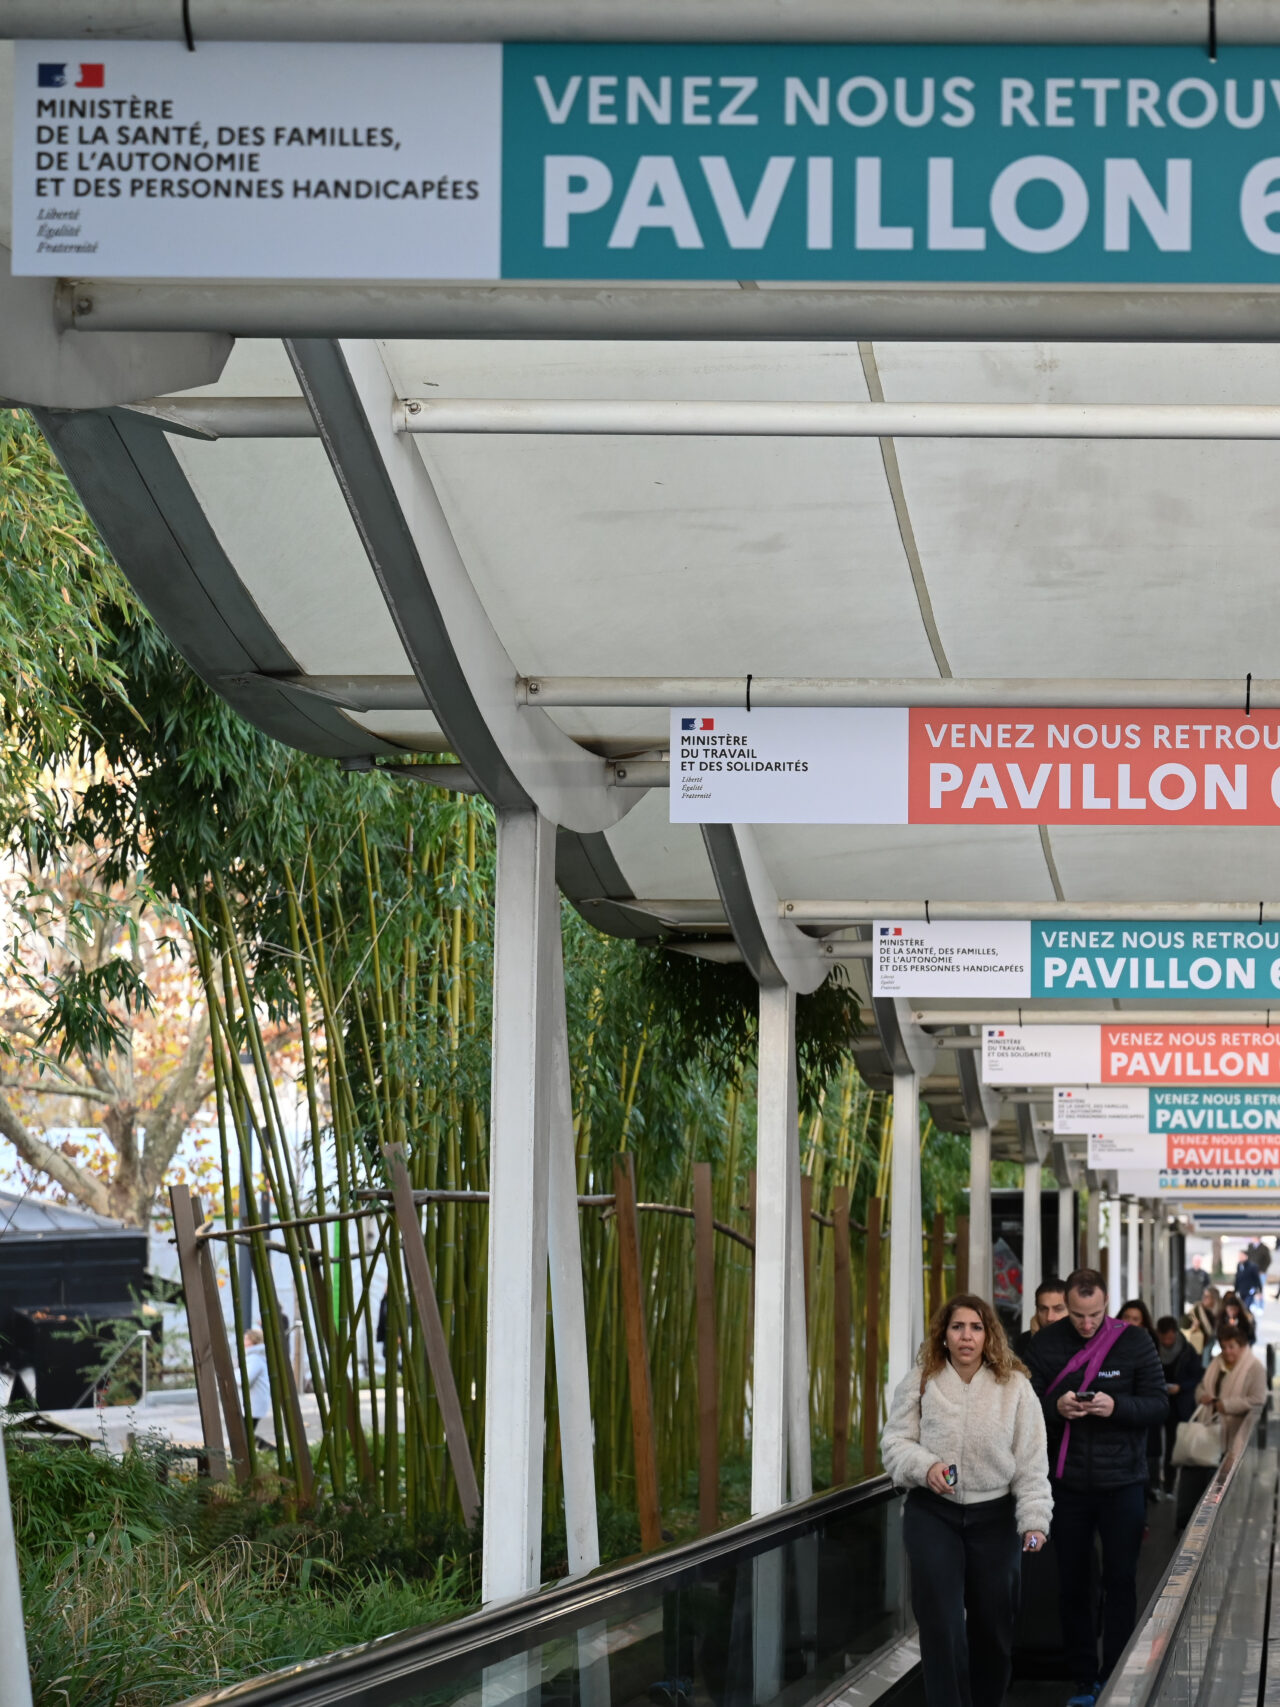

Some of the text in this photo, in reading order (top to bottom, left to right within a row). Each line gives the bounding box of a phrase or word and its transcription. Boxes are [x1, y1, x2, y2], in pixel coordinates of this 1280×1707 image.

[36, 95, 173, 119] MINISTÈRE
[535, 76, 758, 125] VENEZ
[785, 76, 975, 128] NOUS
[36, 122, 401, 150] DE LA SANTÉ, DES FAMILLES,
[36, 152, 68, 171] DE
[36, 175, 479, 200] ET DES PERSONNES HANDICAPÉES
[543, 155, 1191, 253] PAVILLON
[681, 734, 748, 746] MINISTÈRE
[924, 723, 1035, 748] VENEZ
[1047, 724, 1141, 749] NOUS
[681, 748, 757, 759] DU TRAVAIL
[681, 760, 808, 772] ET DES SOLIDARITÉS
[929, 762, 1247, 811] PAVILLON
[1042, 932, 1114, 948] VENEZ
[1122, 932, 1184, 948] NOUS
[963, 964, 1024, 973] HANDICAPÉES
[1044, 957, 1255, 990] PAVILLON
[1109, 1033, 1163, 1045] VENEZ
[1169, 1033, 1216, 1046] NOUS
[1111, 1052, 1269, 1076] PAVILLON
[1155, 1094, 1199, 1104] VENEZ
[1203, 1094, 1241, 1105] NOUS
[1172, 1135, 1210, 1144] VENEZ
[1214, 1135, 1245, 1145] NOUS
[1159, 1178, 1178, 1188] DE
[1185, 1178, 1250, 1188] MOURIR
